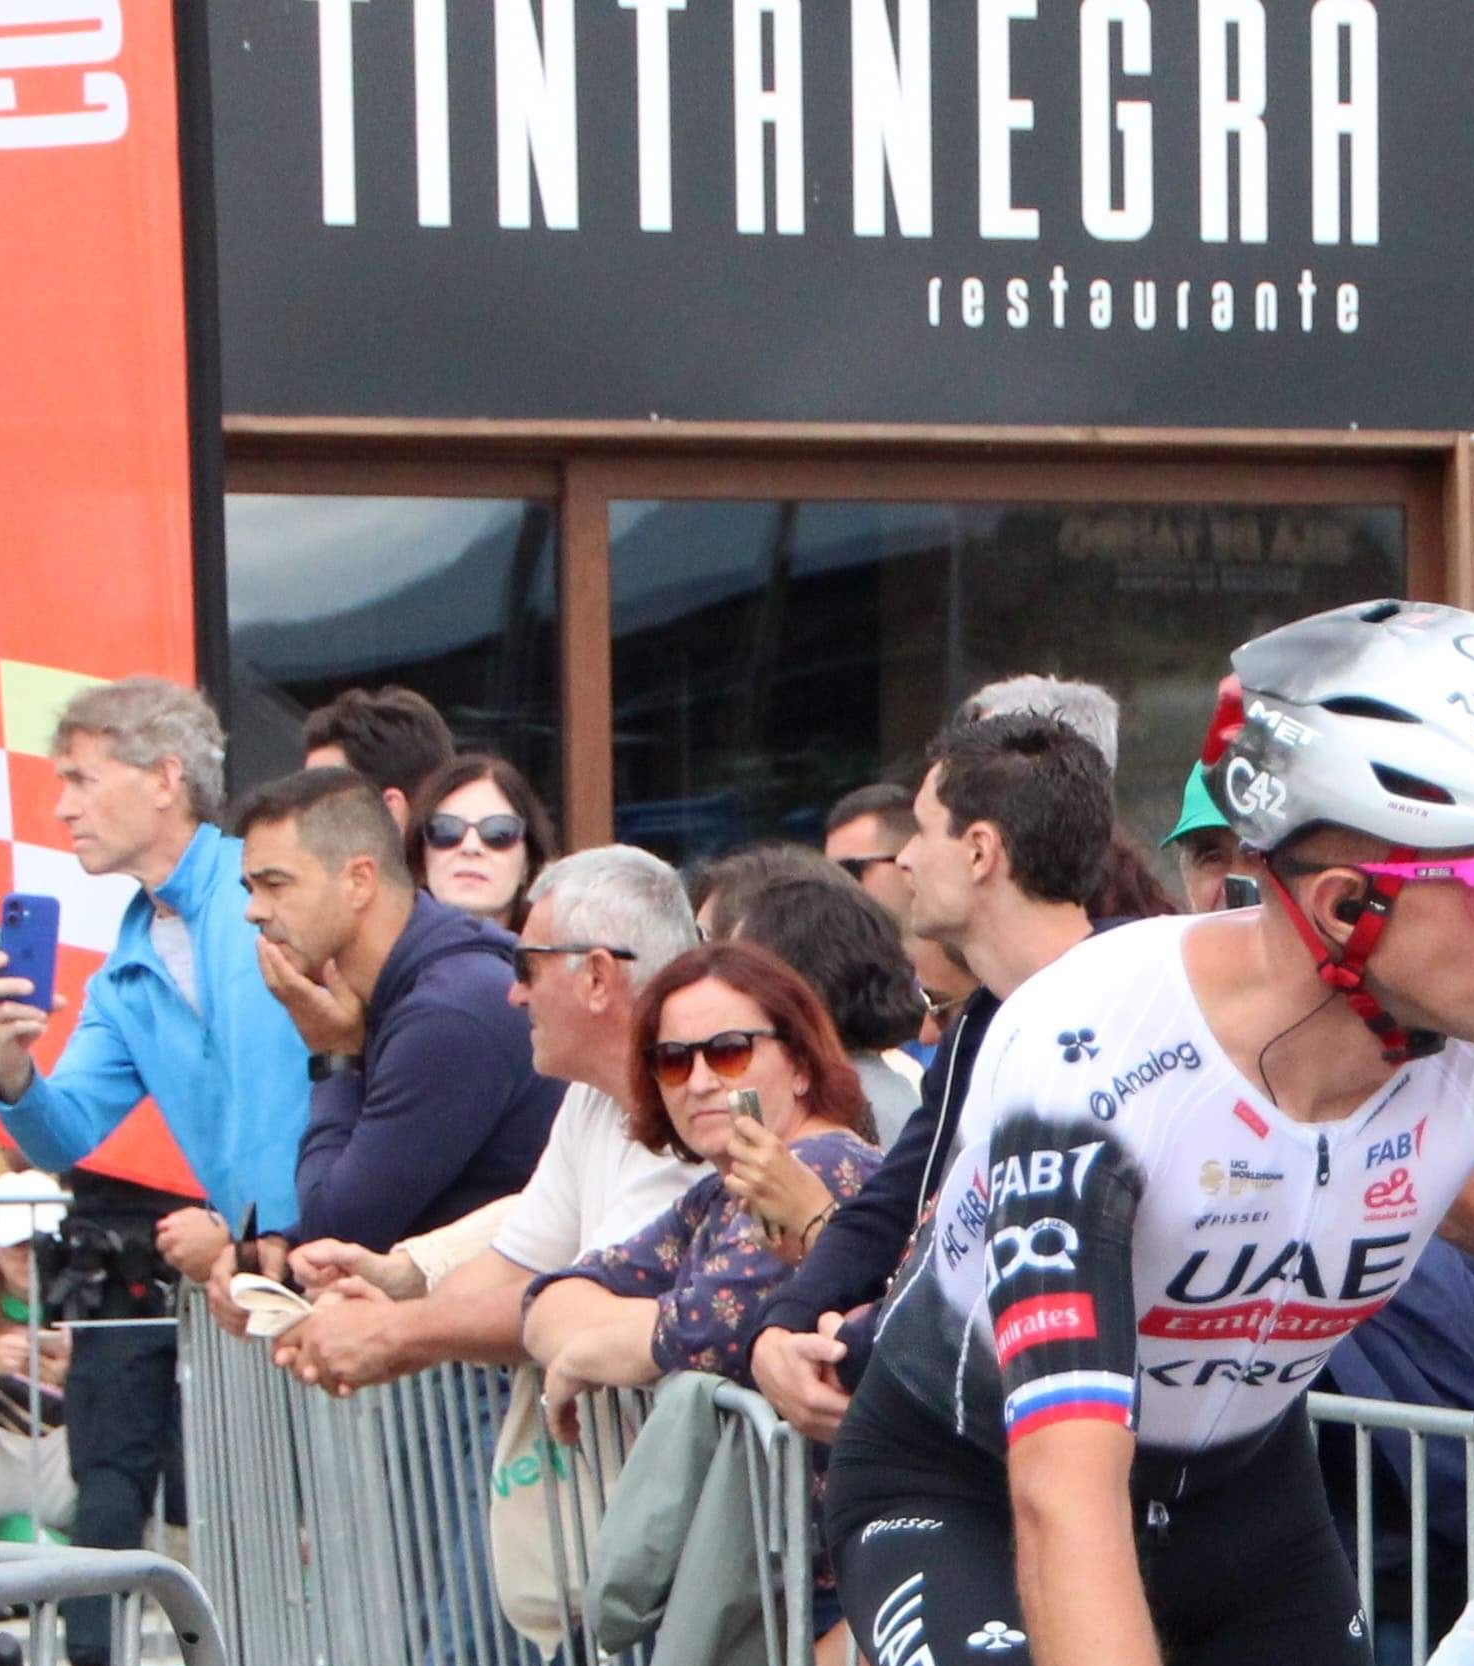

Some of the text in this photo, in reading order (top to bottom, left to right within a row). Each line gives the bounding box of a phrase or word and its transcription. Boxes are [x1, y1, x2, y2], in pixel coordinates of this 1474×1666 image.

[319, 0, 1379, 246] TINTANEGRA
[927, 265, 1360, 334] restaurante
[1246, 700, 1321, 746] MET
[1115, 1040, 1202, 1103] Analog
[1164, 1232, 1412, 1304] UAE
